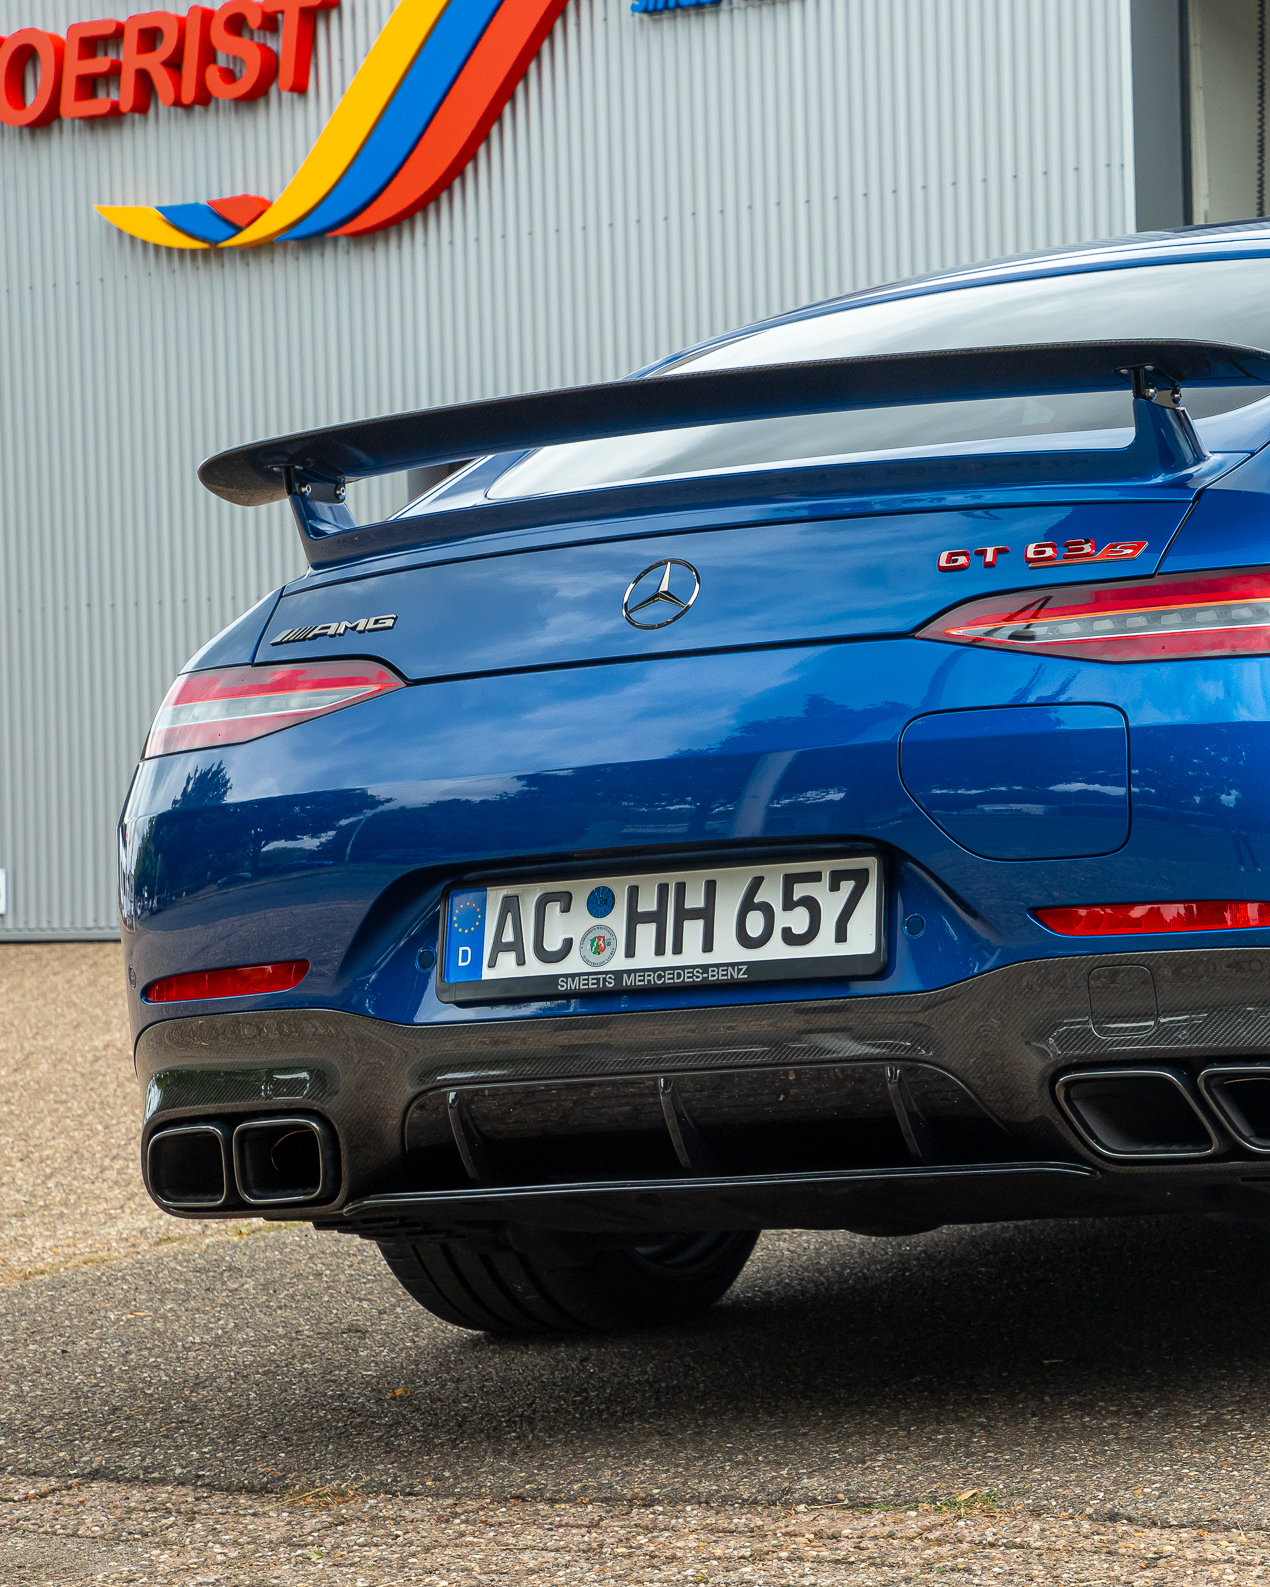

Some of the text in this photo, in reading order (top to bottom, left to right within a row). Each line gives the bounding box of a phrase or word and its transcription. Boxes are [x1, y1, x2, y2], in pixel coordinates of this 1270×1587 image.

[0, 0, 339, 127] OERIST
[937, 545, 1010, 572] GT
[305, 613, 399, 642] AMG
[487, 890, 574, 969] AC
[624, 878, 717, 959] HH
[735, 867, 870, 951] 657
[457, 946, 472, 967] D
[557, 965, 749, 991] SMEETS MERCEDES-BENZ
